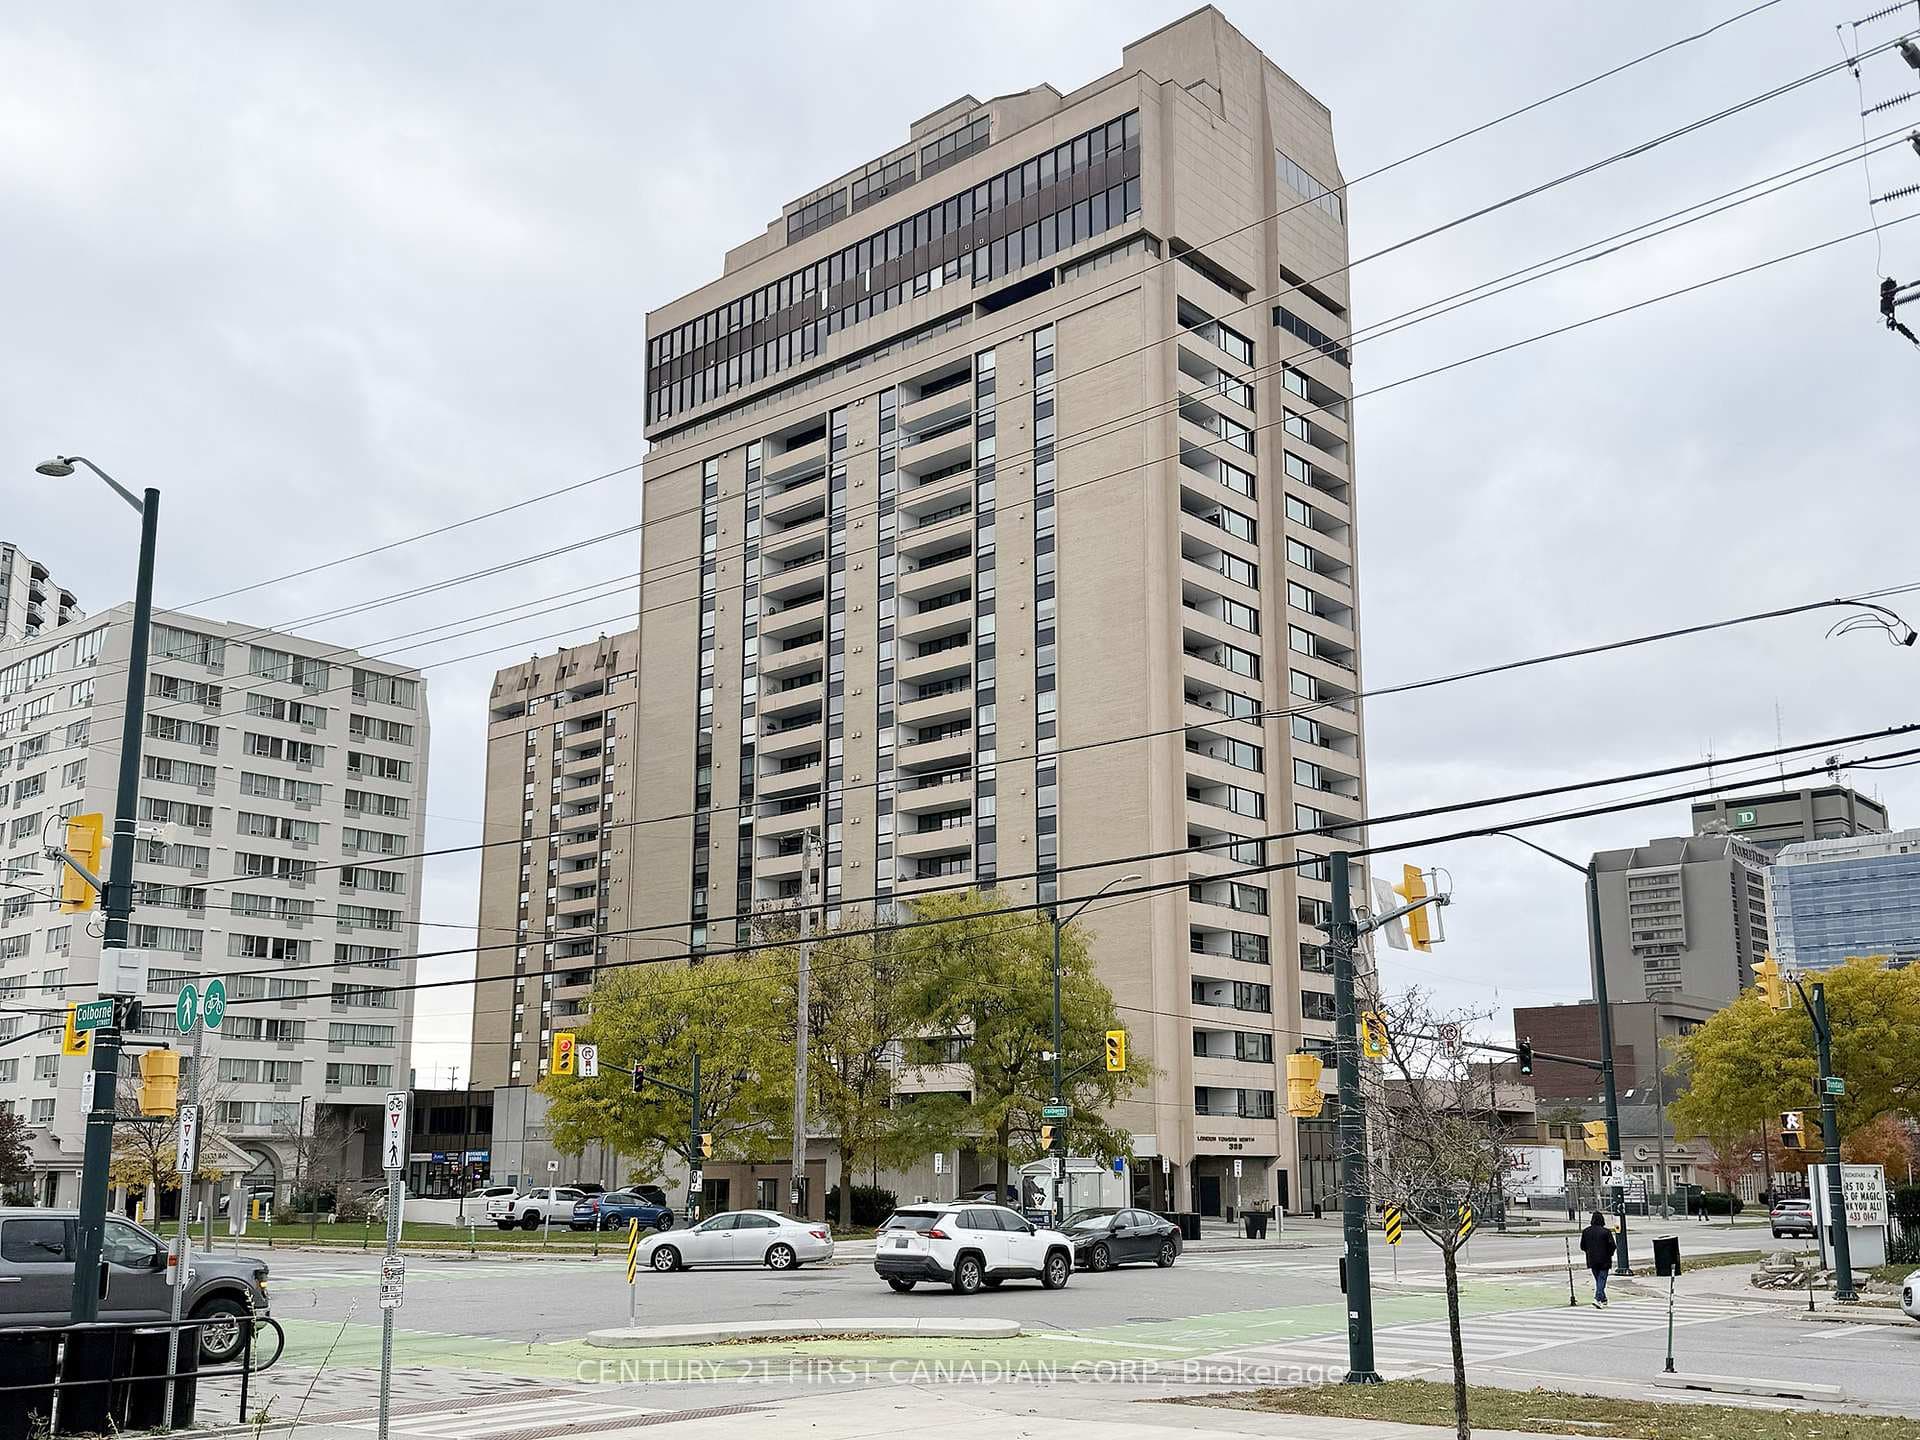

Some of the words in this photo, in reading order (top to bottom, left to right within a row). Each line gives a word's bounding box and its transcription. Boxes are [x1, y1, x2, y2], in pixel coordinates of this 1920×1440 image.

[1738, 812, 1754, 823] TD
[77, 1005, 112, 1022] Colborne
[1856, 1182, 1865, 1191] TO
[1850, 1192, 1859, 1200] OF
[1854, 1202, 1867, 1210] YOU
[1849, 1211, 1861, 1221] 433
